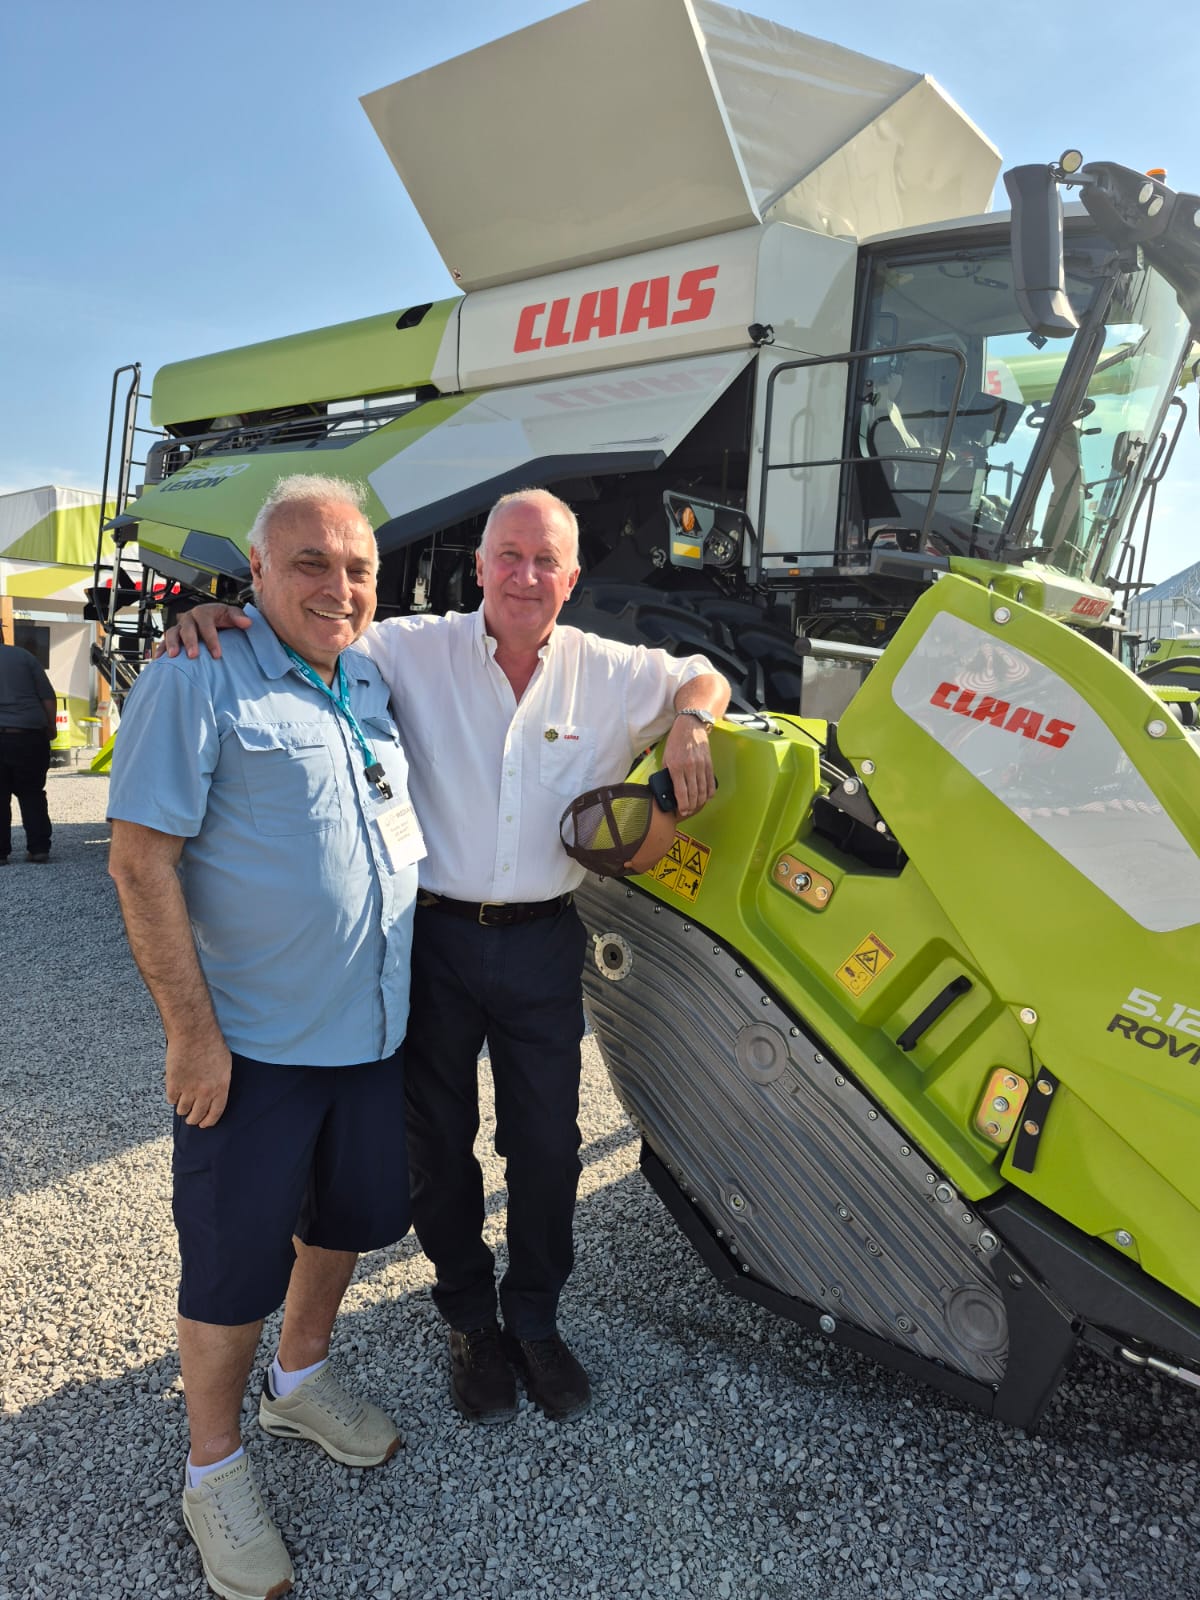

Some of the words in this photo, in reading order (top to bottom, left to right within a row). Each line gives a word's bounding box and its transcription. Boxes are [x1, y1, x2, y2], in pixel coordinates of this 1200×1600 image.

[513, 264, 720, 354] CLAAS
[160, 476, 228, 493] LEXION
[929, 681, 1076, 749] CLAAS
